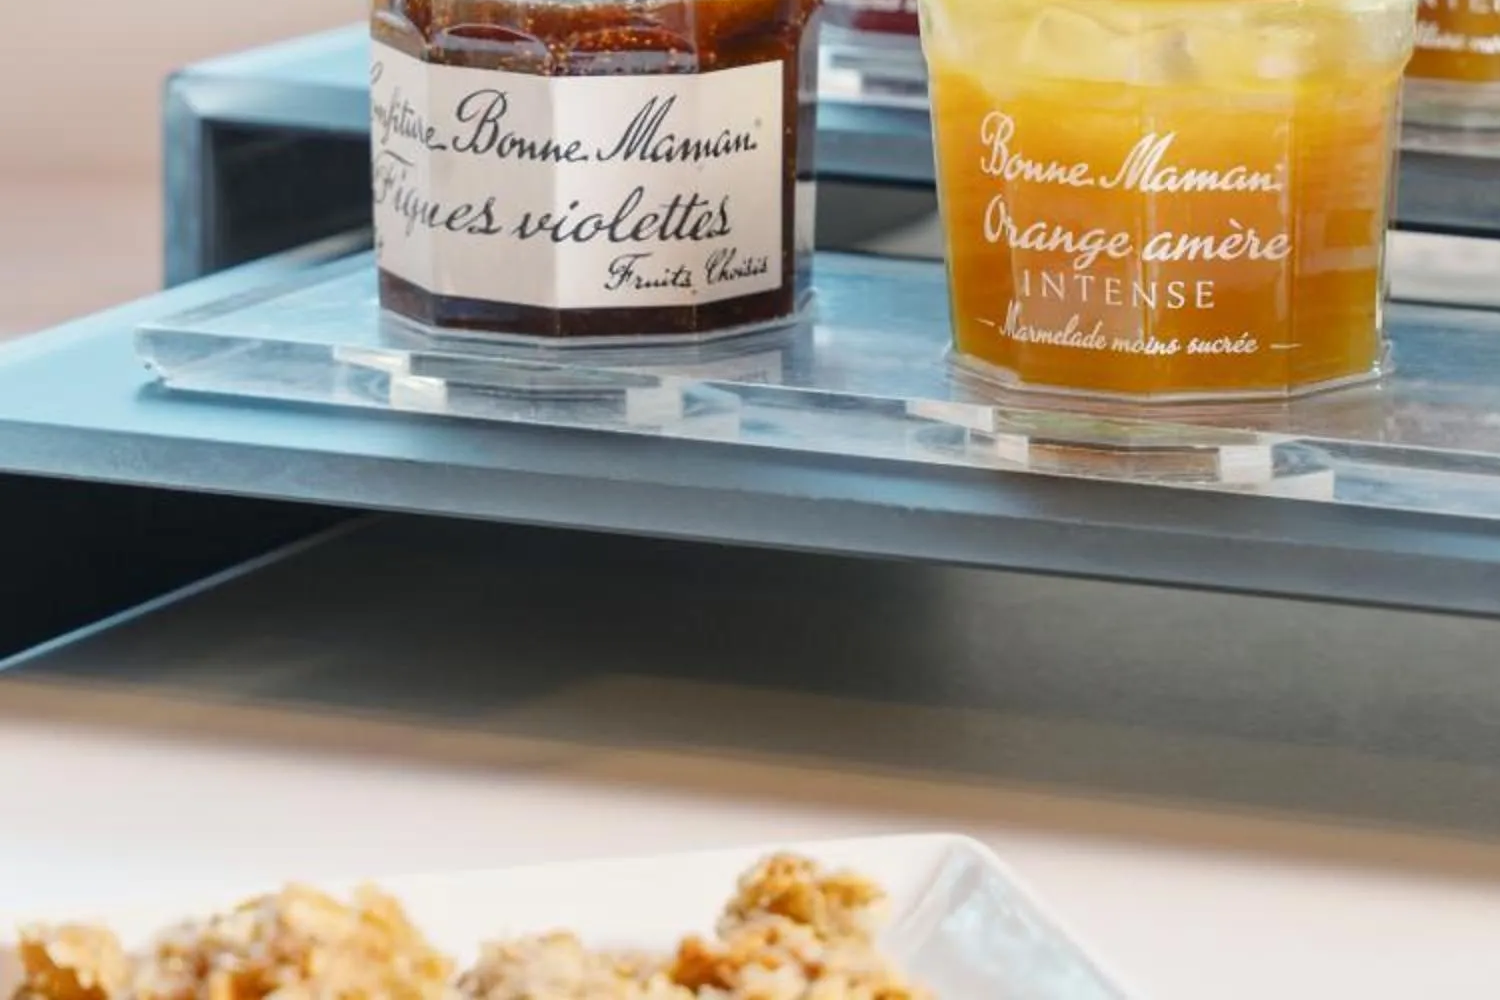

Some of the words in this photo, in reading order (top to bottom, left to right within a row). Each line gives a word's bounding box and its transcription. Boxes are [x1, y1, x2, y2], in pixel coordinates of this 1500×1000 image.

[452, 88, 588, 163] Bonne
[596, 93, 758, 164] Maman
[979, 110, 1095, 184] Bonne
[1100, 130, 1283, 193] Maman
[512, 186, 732, 244] violettes
[982, 194, 1134, 271] Orange
[1141, 218, 1294, 263] amère
[604, 252, 694, 292] Fruits
[1022, 270, 1216, 310] INTENSE
[999, 299, 1107, 352] Marmelade
[1111, 331, 1182, 357] moins
[1186, 331, 1260, 355] sucrée
